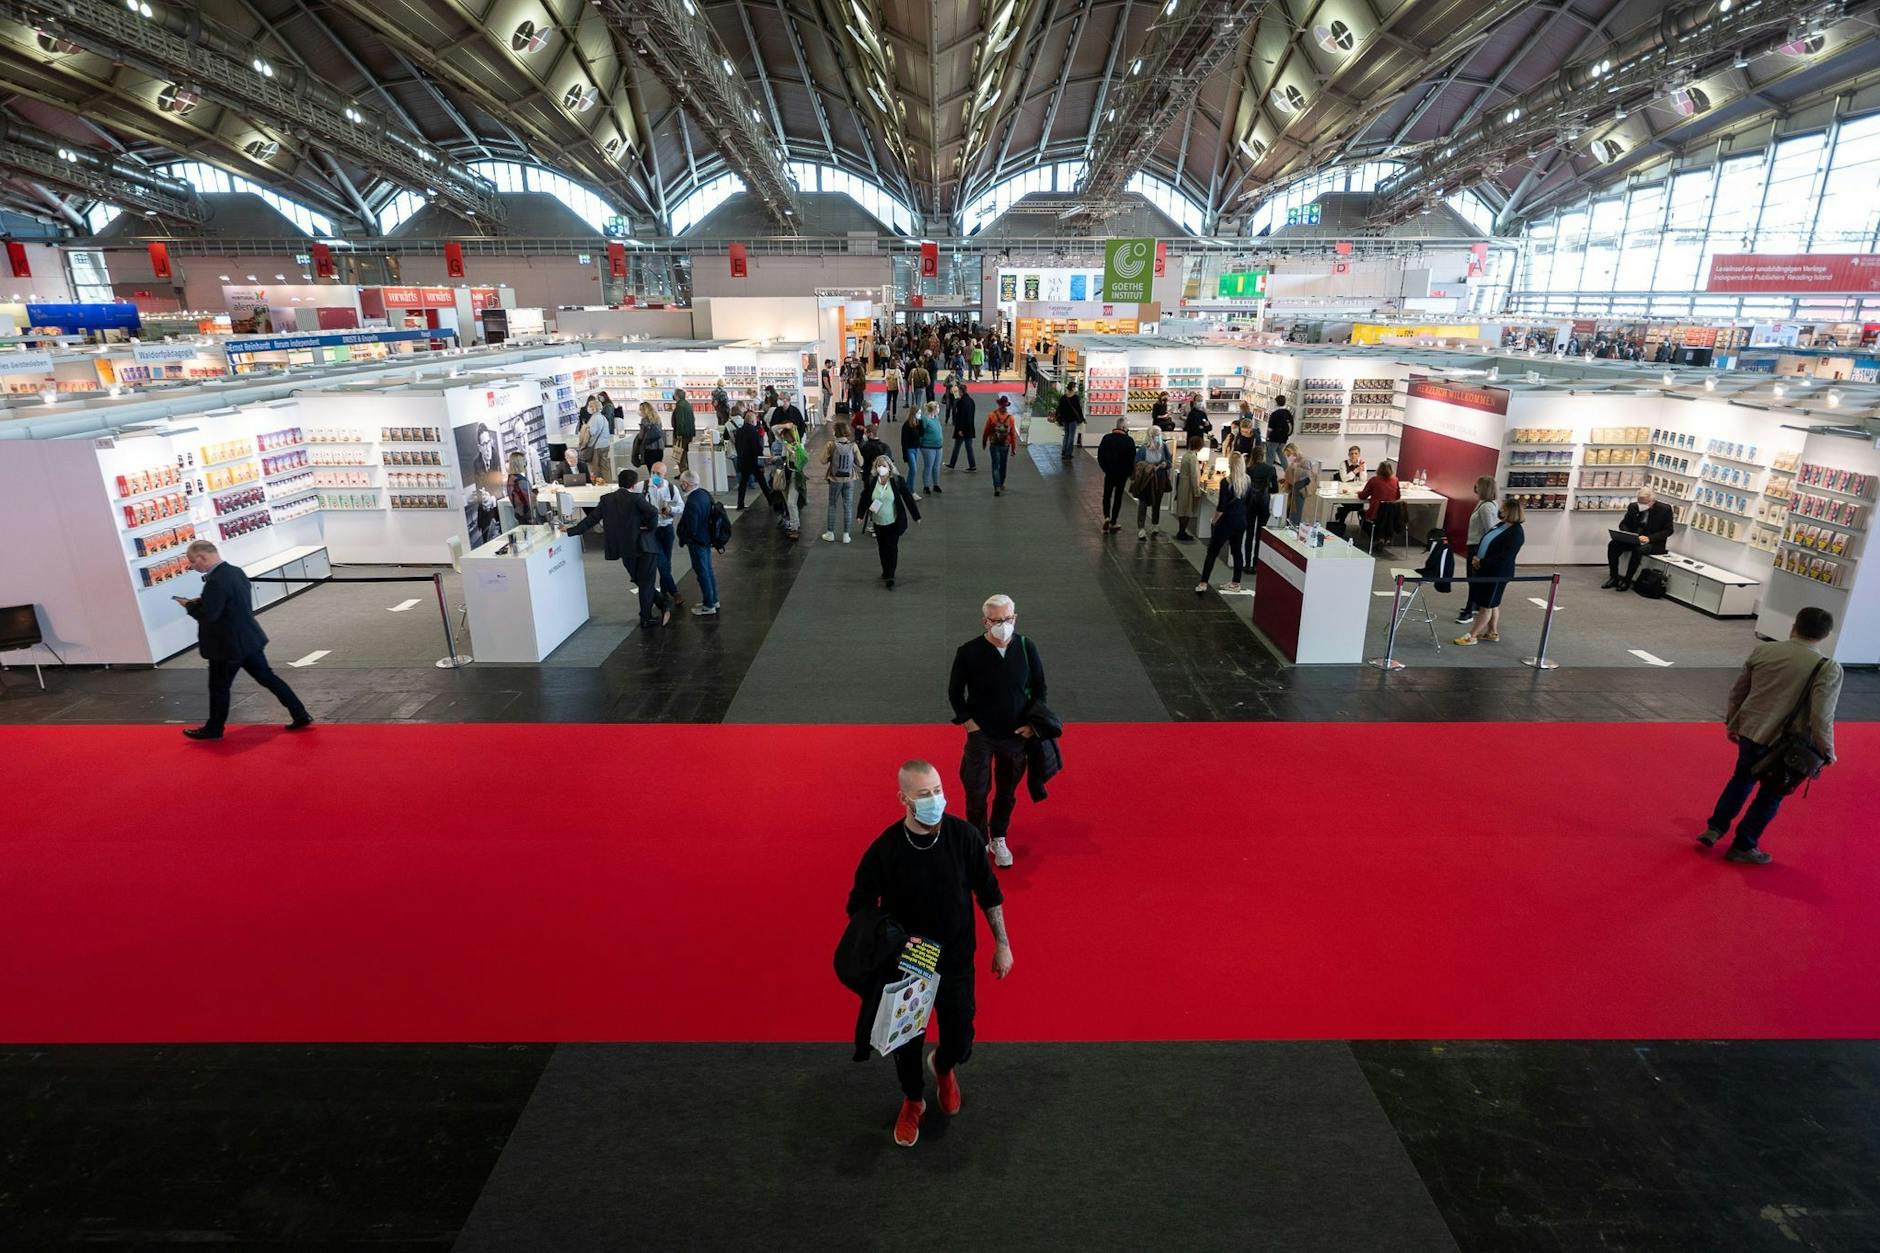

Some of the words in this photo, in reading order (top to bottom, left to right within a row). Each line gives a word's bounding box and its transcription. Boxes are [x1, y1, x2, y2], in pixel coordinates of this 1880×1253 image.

[159, 258, 166, 273] J
[319, 258, 331, 272] H
[450, 258, 461, 273] G
[613, 258, 622, 272] F
[734, 258, 743, 272] E
[925, 258, 935, 272] D
[1337, 263, 1346, 272] D
[1472, 259, 1482, 272] A
[1756, 265, 1802, 274] unabhängigen
[1803, 265, 1827, 274] Verlage
[1112, 283, 1144, 291] GOETHE
[388, 290, 418, 302] vorwärts
[426, 290, 452, 302] vorwärts
[1111, 292, 1143, 300] INSTITUT
[244, 341, 272, 350] Reinhardt
[138, 349, 194, 360] Waldorfpädagogik
[1417, 384, 1447, 397] HERZLICH
[1448, 390, 1496, 406] WILLKOMMEN
